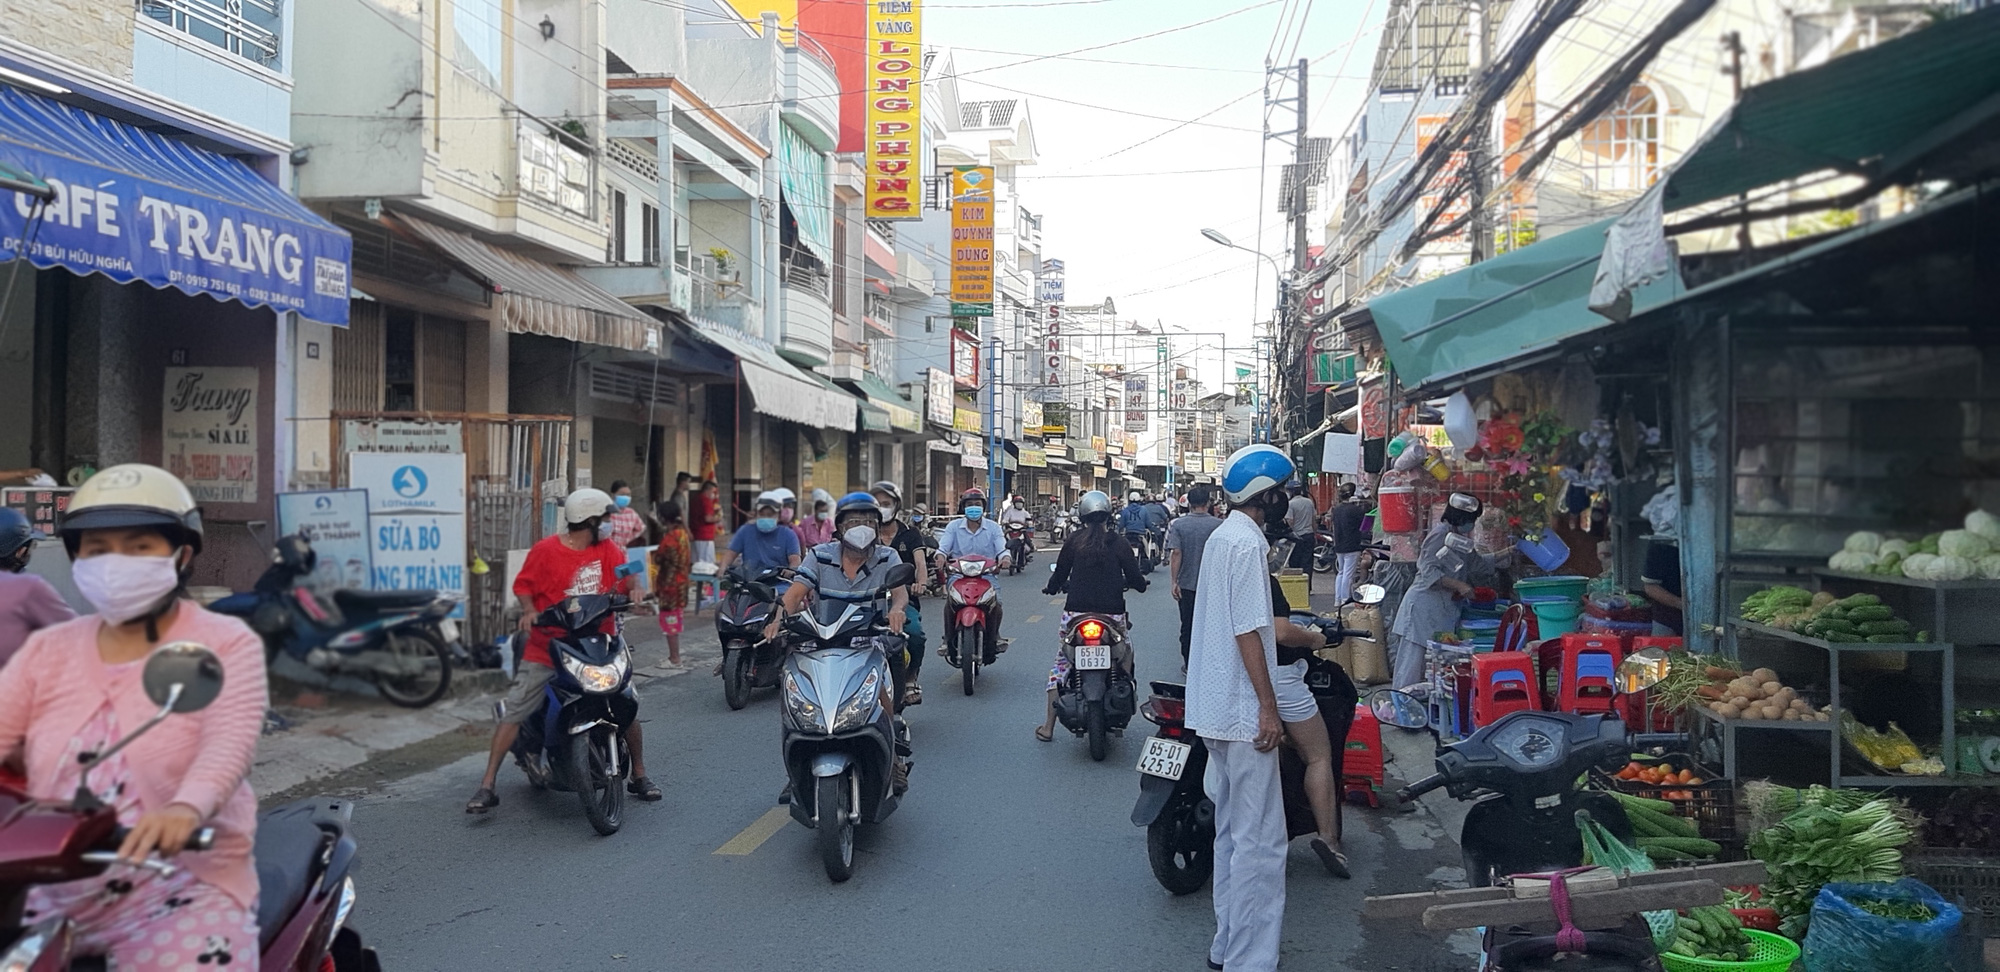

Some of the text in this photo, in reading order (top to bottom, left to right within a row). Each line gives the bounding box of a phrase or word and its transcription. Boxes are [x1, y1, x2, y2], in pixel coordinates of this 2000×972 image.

[876, 18, 913, 34] VÀNG
[874, 40, 913, 112] LONG
[962, 207, 985, 220] KIM
[14, 177, 303, 283] CAFÉ TRANG
[953, 225, 993, 241] QUỲNH
[44, 245, 65, 261] BÙI
[68, 247, 94, 266] HỮU
[96, 255, 133, 273] NGHĨA
[170, 270, 185, 284] ĐT:
[186, 273, 208, 288] 0919
[210, 278, 225, 292] 751
[1043, 279, 1062, 291] TIỆM
[1042, 292, 1064, 301] VÀNG
[382, 500, 436, 508] LOTHAMILK
[379, 517, 441, 551] SỮA BÒ
[1080, 647, 1105, 657] 65-U2
[1080, 658, 1106, 668] 0632
[1149, 740, 1182, 761] 65-D1
[1140, 759, 1182, 777] 425.30
